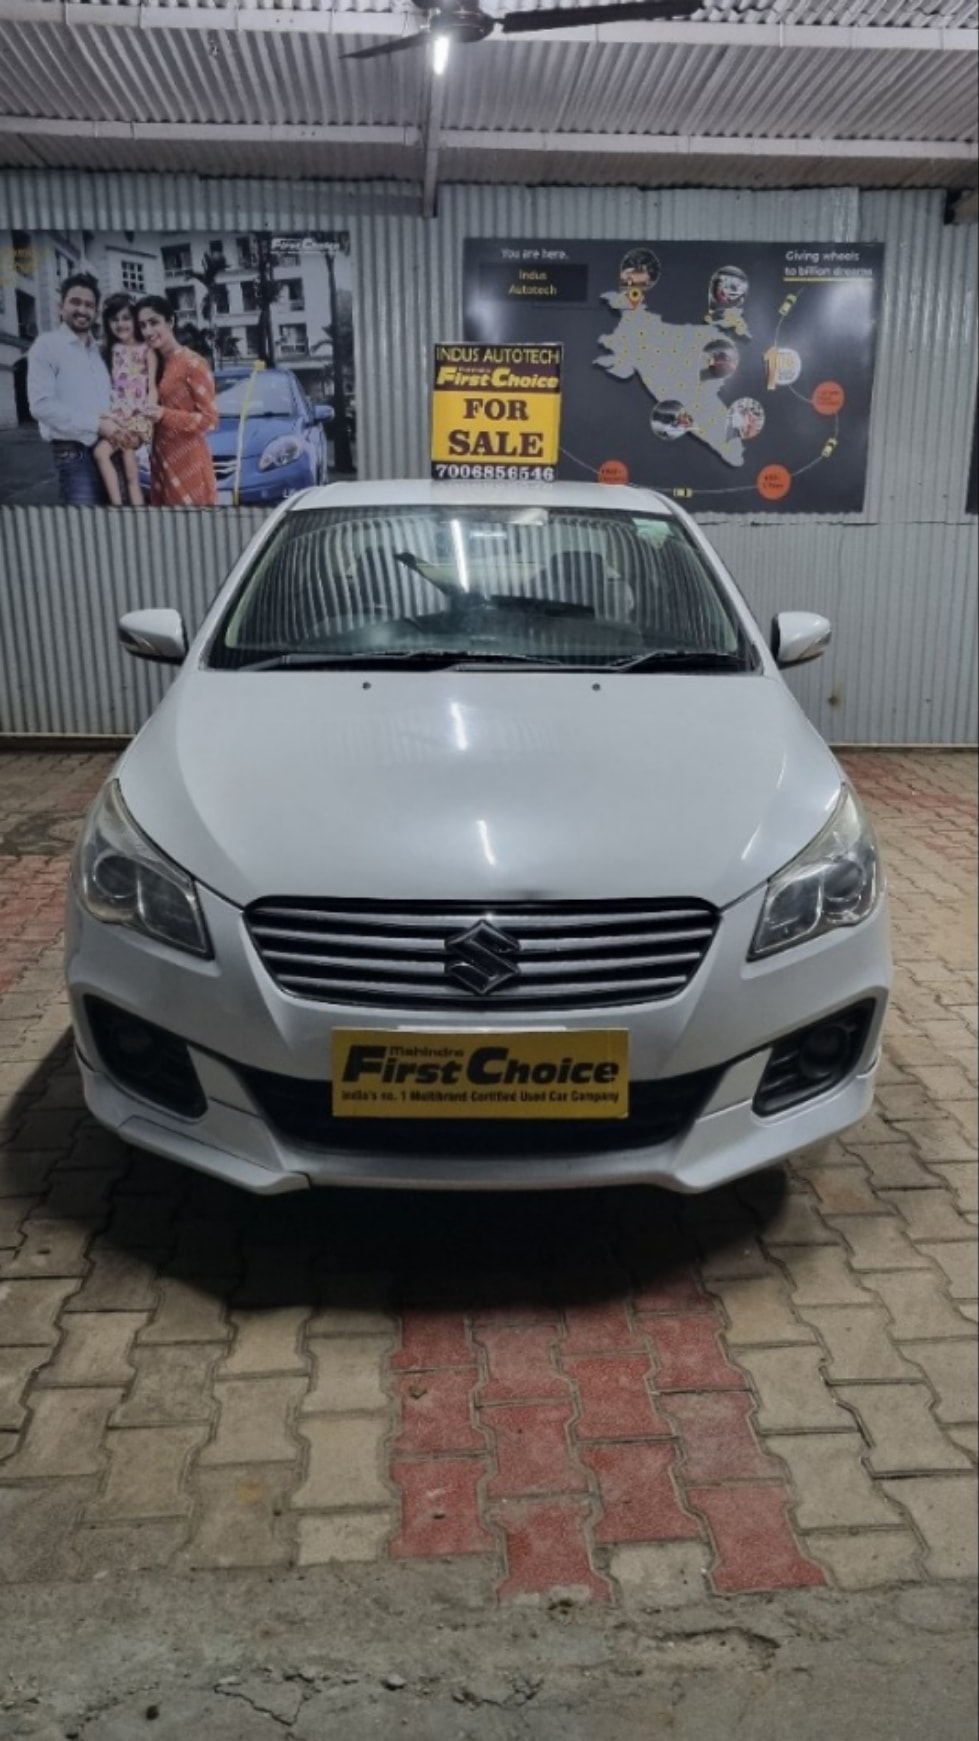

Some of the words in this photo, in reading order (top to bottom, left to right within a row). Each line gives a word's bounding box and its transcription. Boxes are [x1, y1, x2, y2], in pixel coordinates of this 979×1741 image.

[501, 249, 519, 259] You
[522, 250, 539, 259] are
[541, 249, 569, 259] here.
[785, 251, 819, 263] Giving
[822, 251, 860, 261] wheels
[518, 269, 547, 280] Indus
[784, 267, 797, 276] to
[798, 265, 831, 277] billion
[832, 266, 873, 277] dreams
[508, 284, 557, 296] Autotech
[436, 347, 479, 362] INDUS
[482, 348, 560, 364] AUTOTECH
[463, 398, 528, 420] FOR
[448, 429, 544, 458] SALE
[436, 464, 555, 481] 7006856546
[390, 1045, 464, 1057] Mahindra
[342, 1045, 463, 1084] First
[466, 1046, 619, 1085] Choice
[410, 1090, 467, 1102] Multibrand
[471, 1090, 517, 1102] Certified
[520, 1090, 546, 1102] Used
[550, 1090, 567, 1102] Car
[570, 1090, 620, 1104] Company
